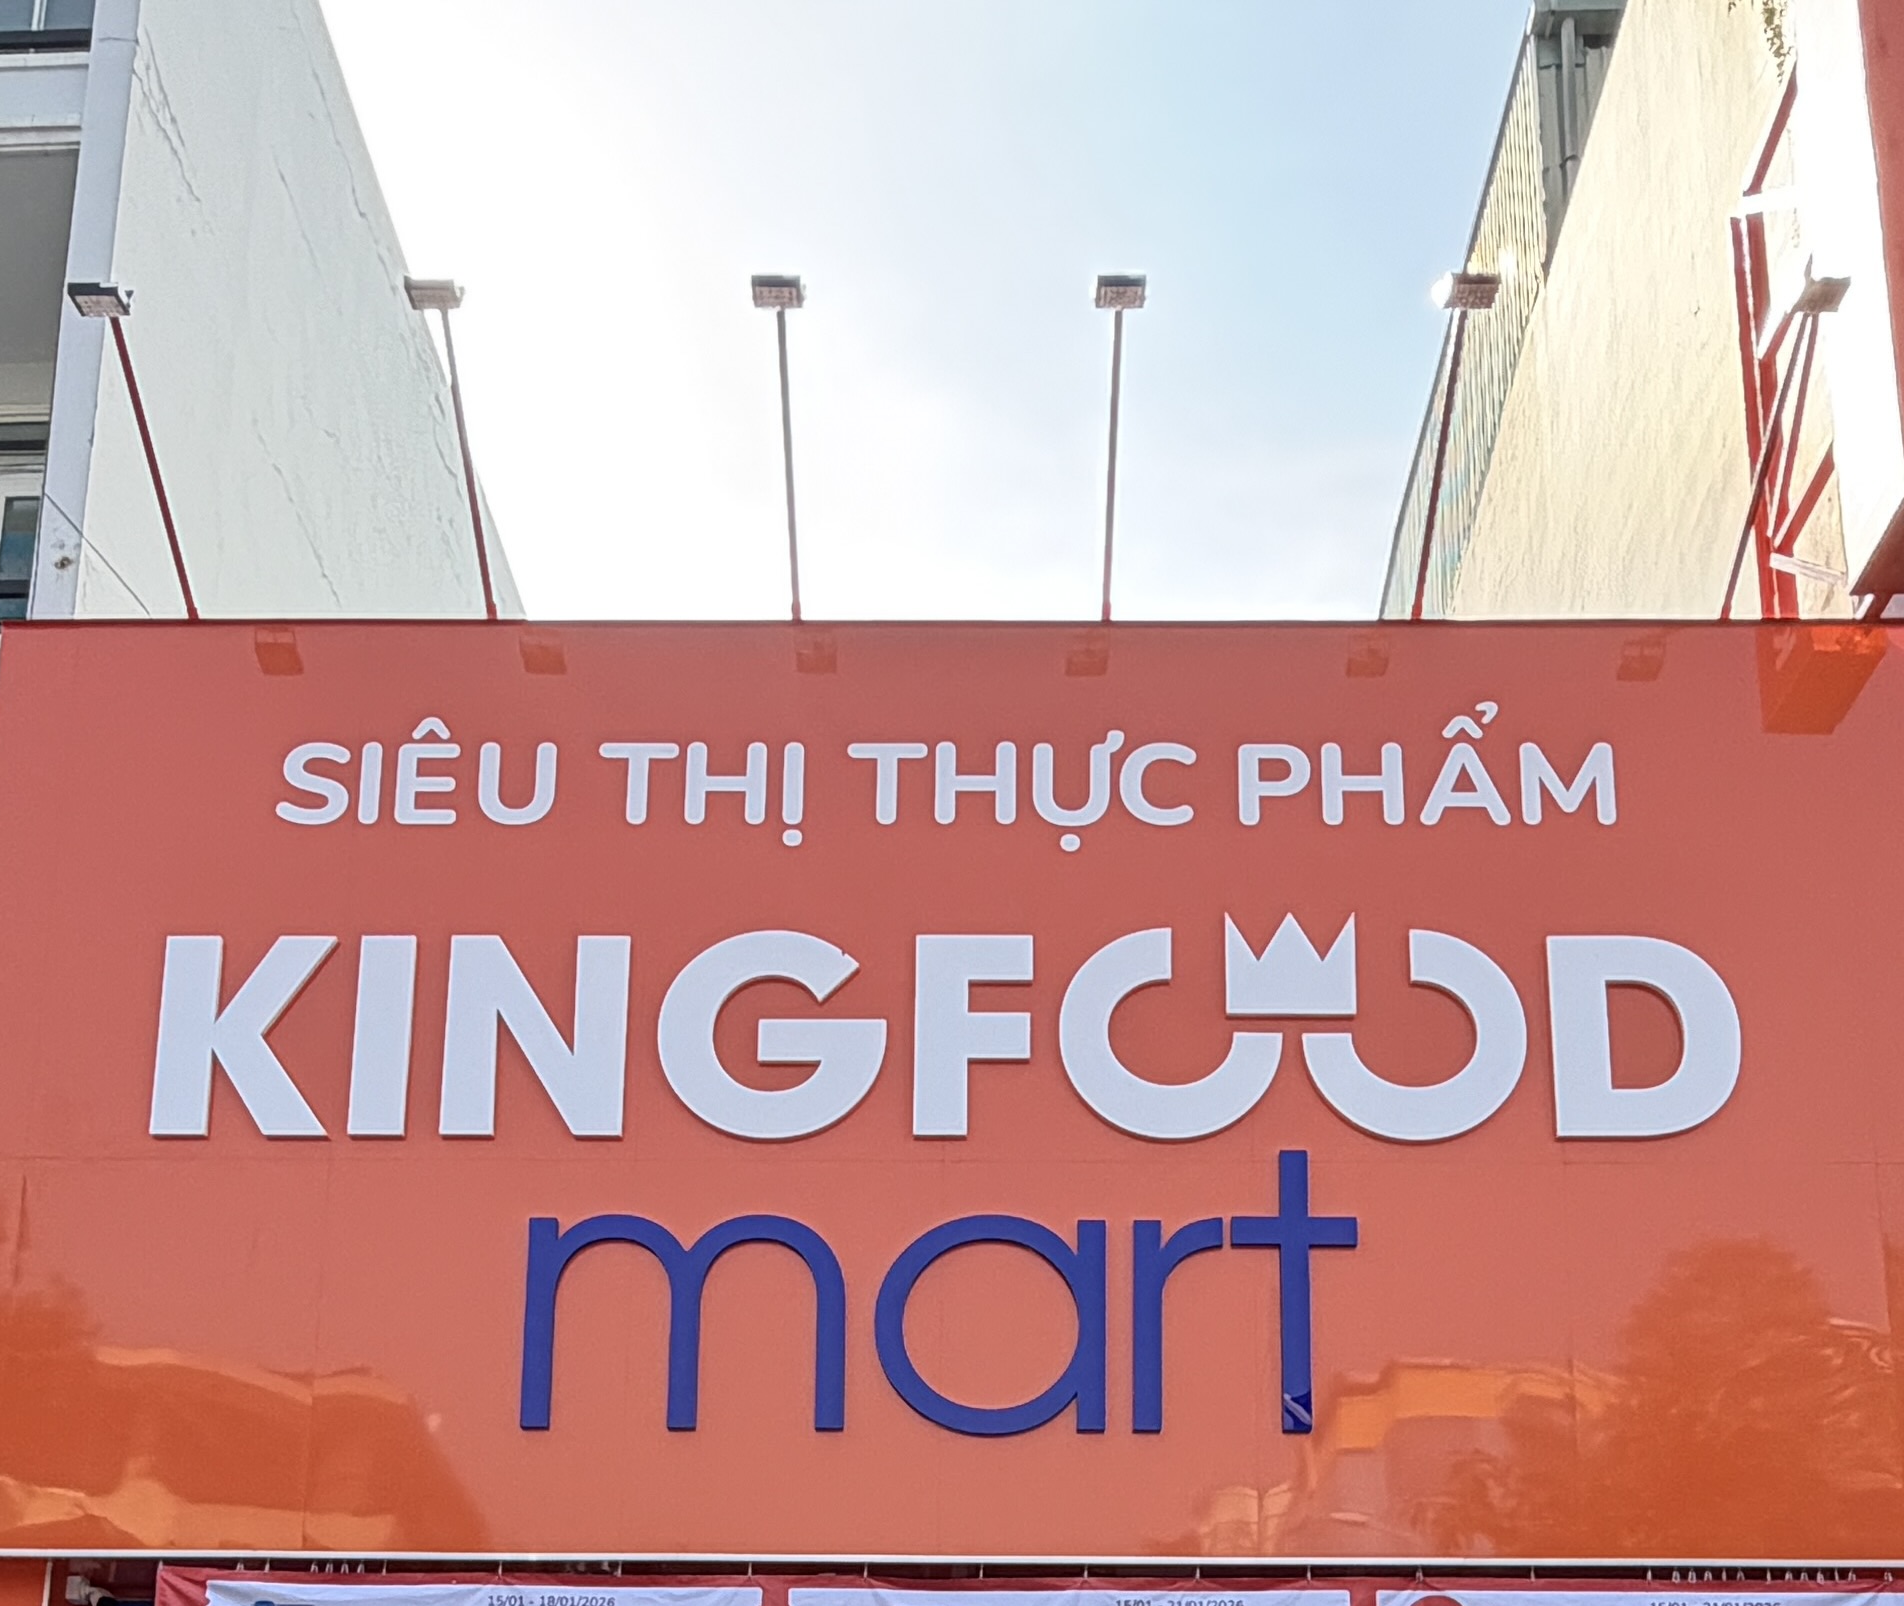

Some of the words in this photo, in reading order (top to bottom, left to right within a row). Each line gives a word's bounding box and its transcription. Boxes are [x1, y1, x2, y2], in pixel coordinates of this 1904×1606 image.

[274, 716, 558, 826] SIÊU
[598, 741, 806, 847] THỊ
[847, 729, 1197, 853] THỰC
[1237, 702, 1618, 826] PHẨM
[149, 912, 1742, 1143] KINGFOOD
[519, 1149, 1359, 1438] mart
